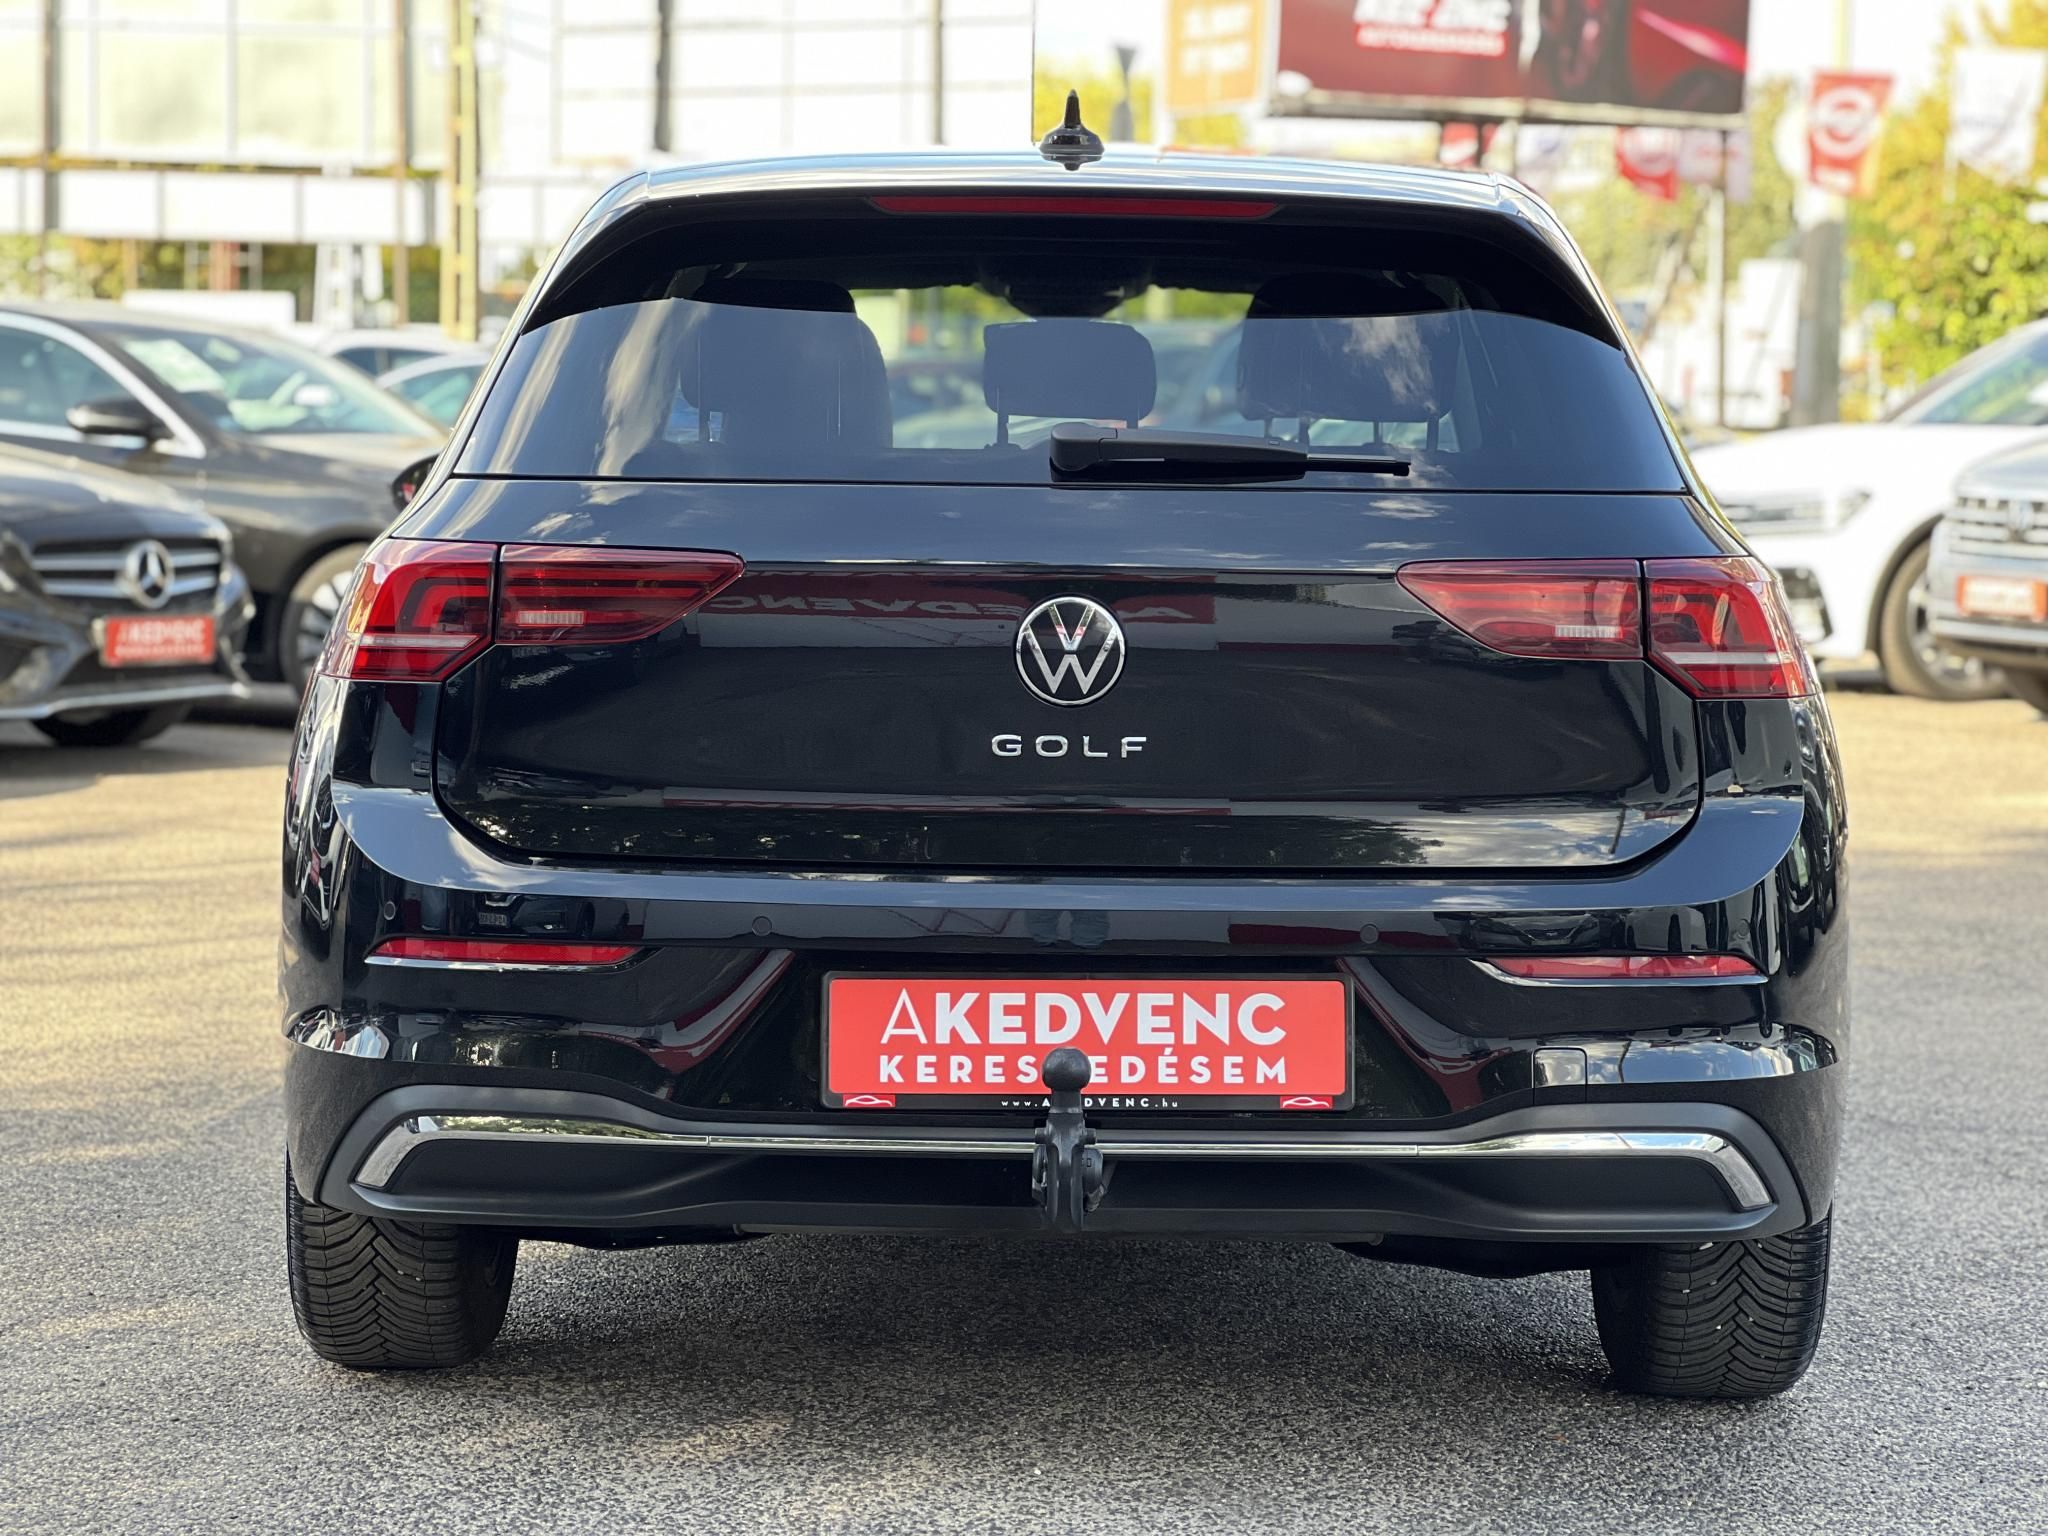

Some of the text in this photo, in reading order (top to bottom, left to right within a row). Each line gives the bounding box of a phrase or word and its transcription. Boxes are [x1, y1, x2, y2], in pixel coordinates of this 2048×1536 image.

[991, 734, 1147, 758] GOLF
[879, 1047, 1287, 1084] KERESEDÉSEM
[1001, 1097, 1178, 1109] www.ADVENC.hu
